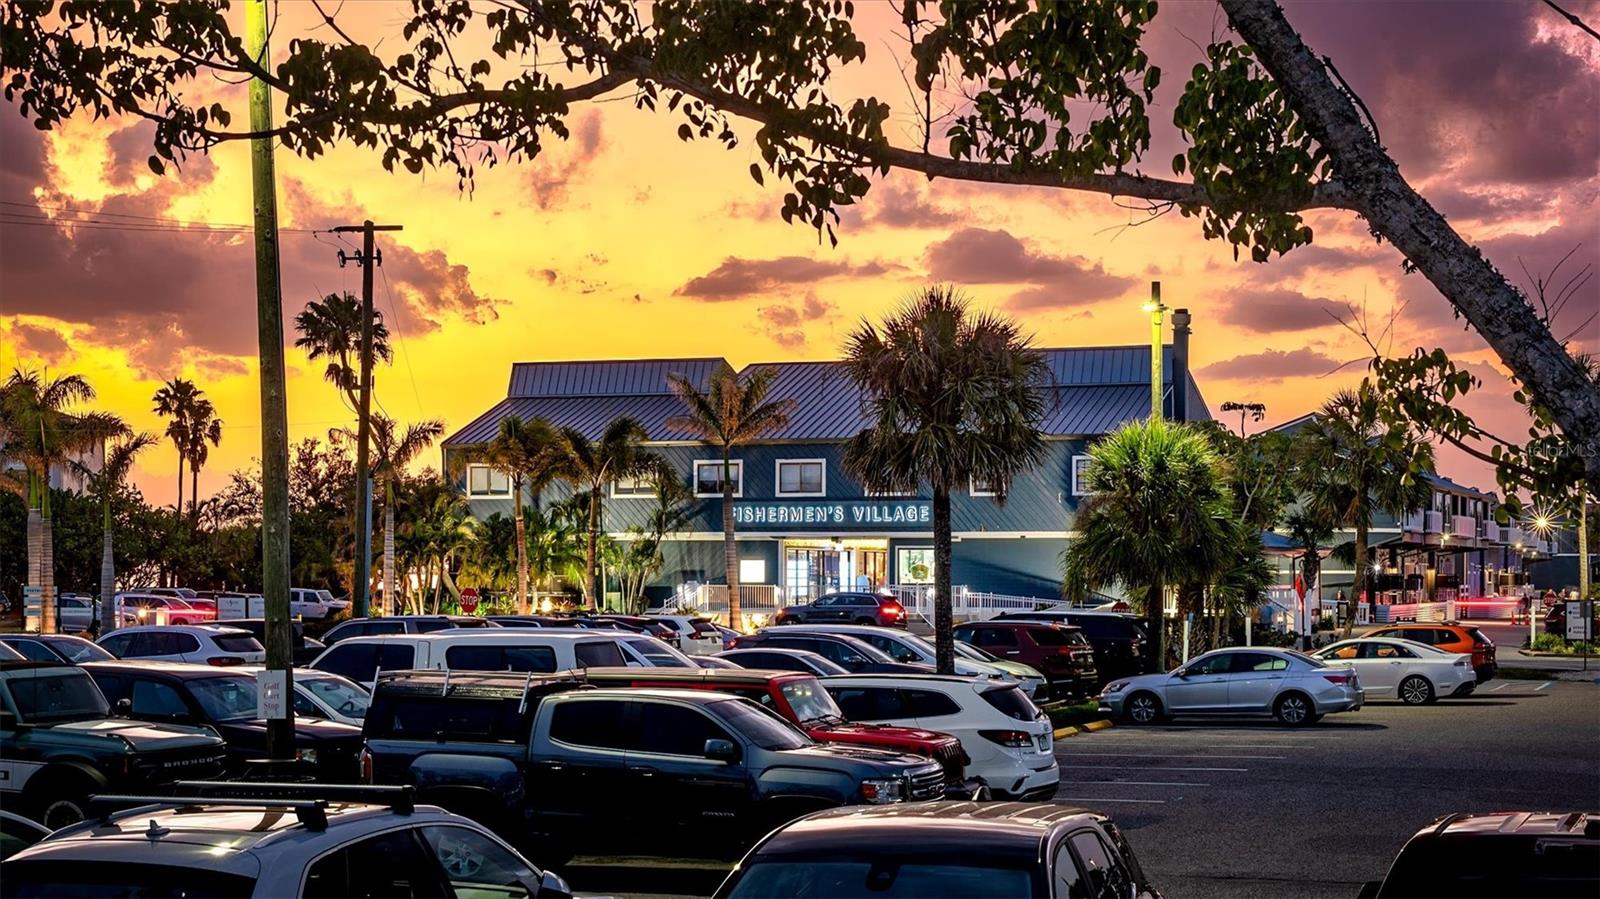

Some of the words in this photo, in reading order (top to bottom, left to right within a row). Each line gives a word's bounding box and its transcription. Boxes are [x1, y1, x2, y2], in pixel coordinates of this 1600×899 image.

[852, 506, 929, 522] VILLAGE
[461, 595, 477, 606] STOP
[263, 682, 280, 690] Golf
[263, 702, 280, 711] Stop
[163, 756, 214, 768] BRONCO
